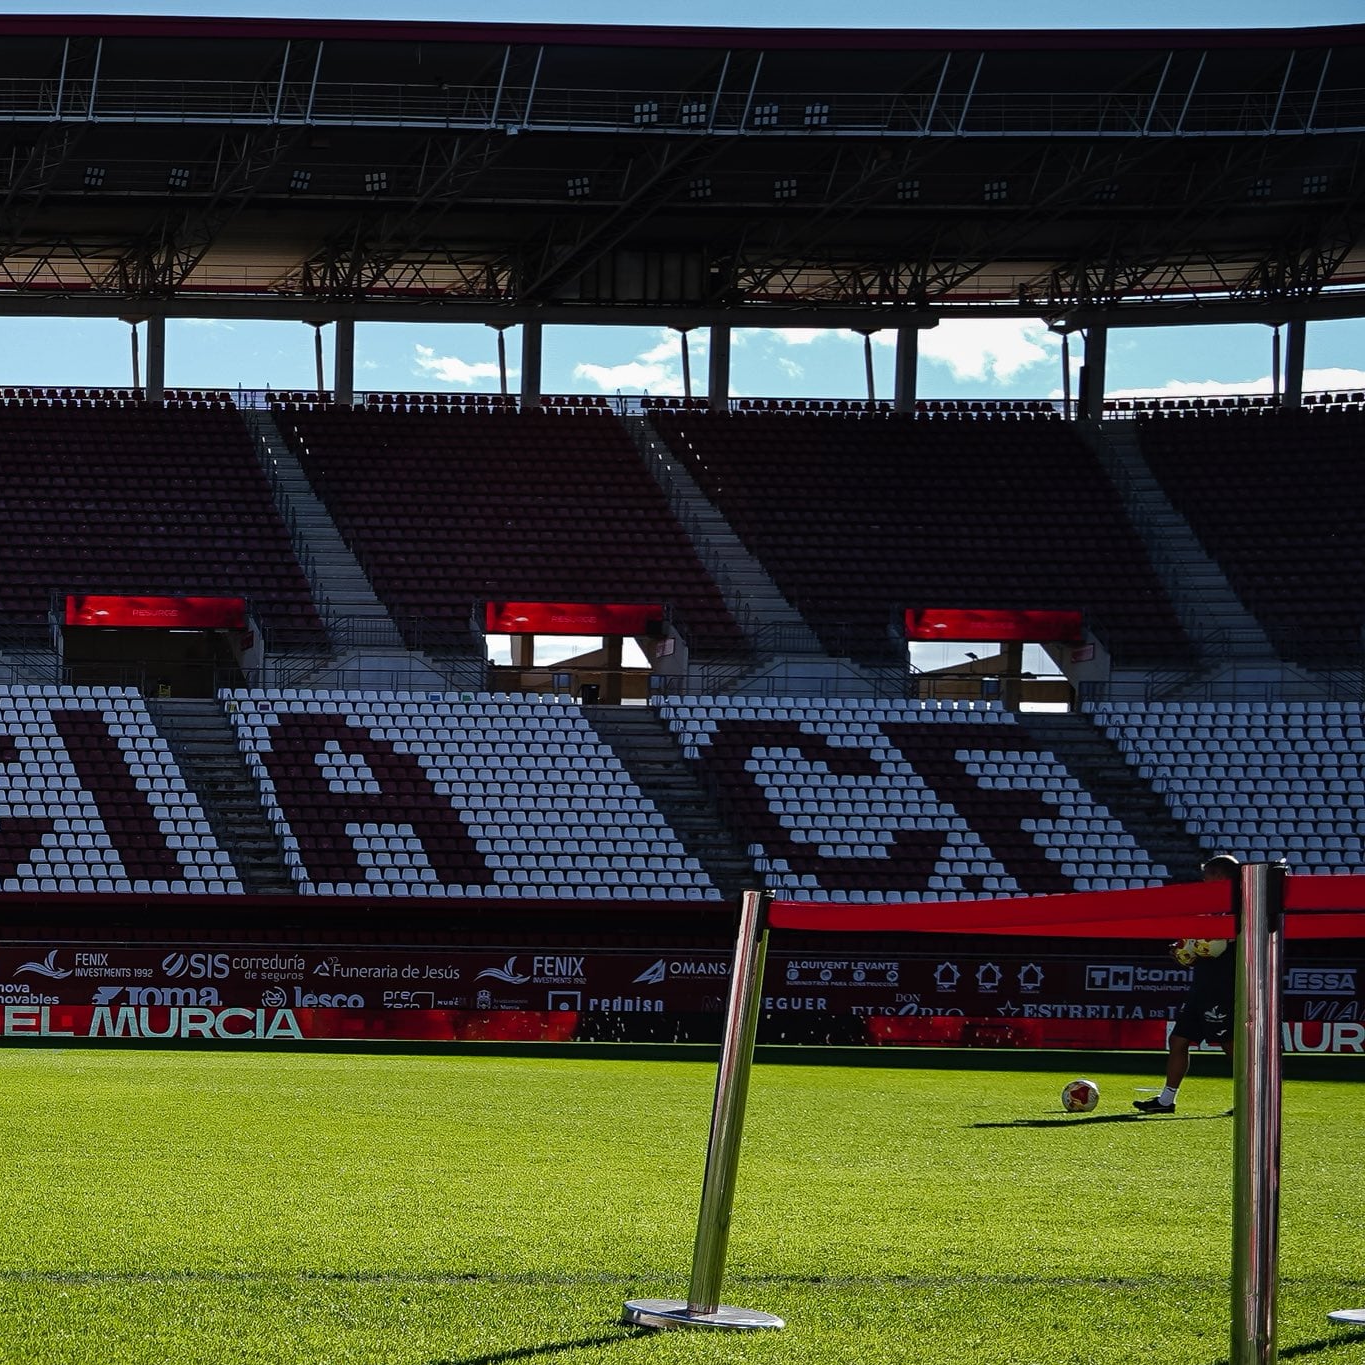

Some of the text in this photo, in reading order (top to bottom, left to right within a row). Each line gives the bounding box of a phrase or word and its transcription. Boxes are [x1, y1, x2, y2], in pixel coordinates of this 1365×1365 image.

[699, 721, 1075, 892] CF
[74, 953, 109, 966] FENIX
[190, 953, 230, 979] SIS
[232, 954, 305, 971] correduría
[532, 956, 585, 977] FENIX
[786, 961, 900, 971] ALQUIVENT LEVANTE
[74, 967, 153, 978] INVESTMENTS 1992
[243, 970, 304, 983] de seguros
[333, 963, 460, 980] Funeraria de Jesús
[294, 986, 364, 1008] lesco
[383, 990, 411, 1001] pre
[895, 993, 921, 1003] DON
[1023, 1004, 1144, 1019] ESTRELLA
[1149, 1010, 1165, 1018] DE
[4, 1005, 304, 1039] EL MURCIA
